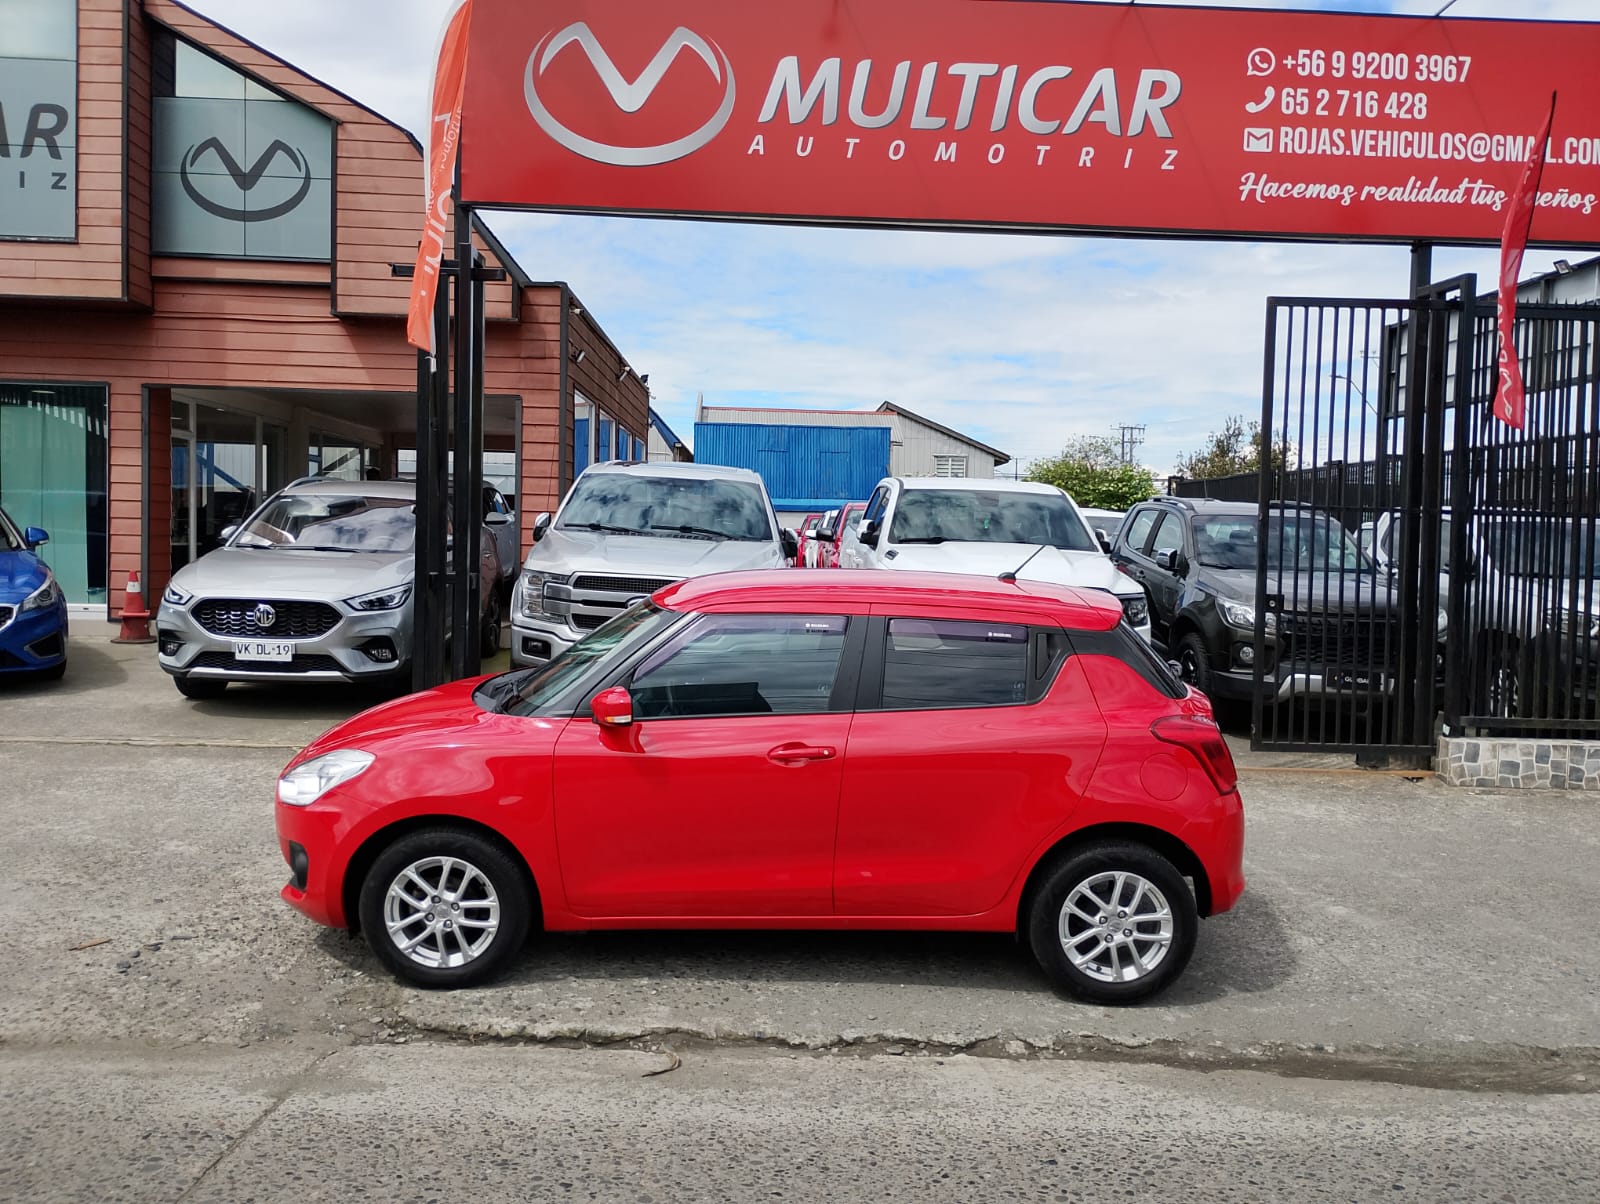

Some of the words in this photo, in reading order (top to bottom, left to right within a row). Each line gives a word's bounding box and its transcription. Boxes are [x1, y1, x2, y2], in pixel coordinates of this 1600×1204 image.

[1282, 49, 1325, 77] +56
[1332, 51, 1346, 78] 9
[1352, 51, 1408, 81] 9200
[1415, 54, 1472, 83] 3967
[757, 55, 1182, 138] MULTICAR
[1281, 87, 1309, 115] 65
[1316, 89, 1329, 116] 2
[1337, 89, 1379, 118] 716
[1384, 92, 1428, 120] 428
[0, 100, 69, 160] R
[1279, 126, 1600, 166] ROJAS.VEHICULOS@GMAL.CO
[748, 134, 1178, 170] AUTOMOTRIZ
[1239, 171, 1358, 206] Hacemos
[1360, 175, 1468, 204] realidad
[1463, 178, 1508, 211] tus
[237, 643, 251, 655] VK
